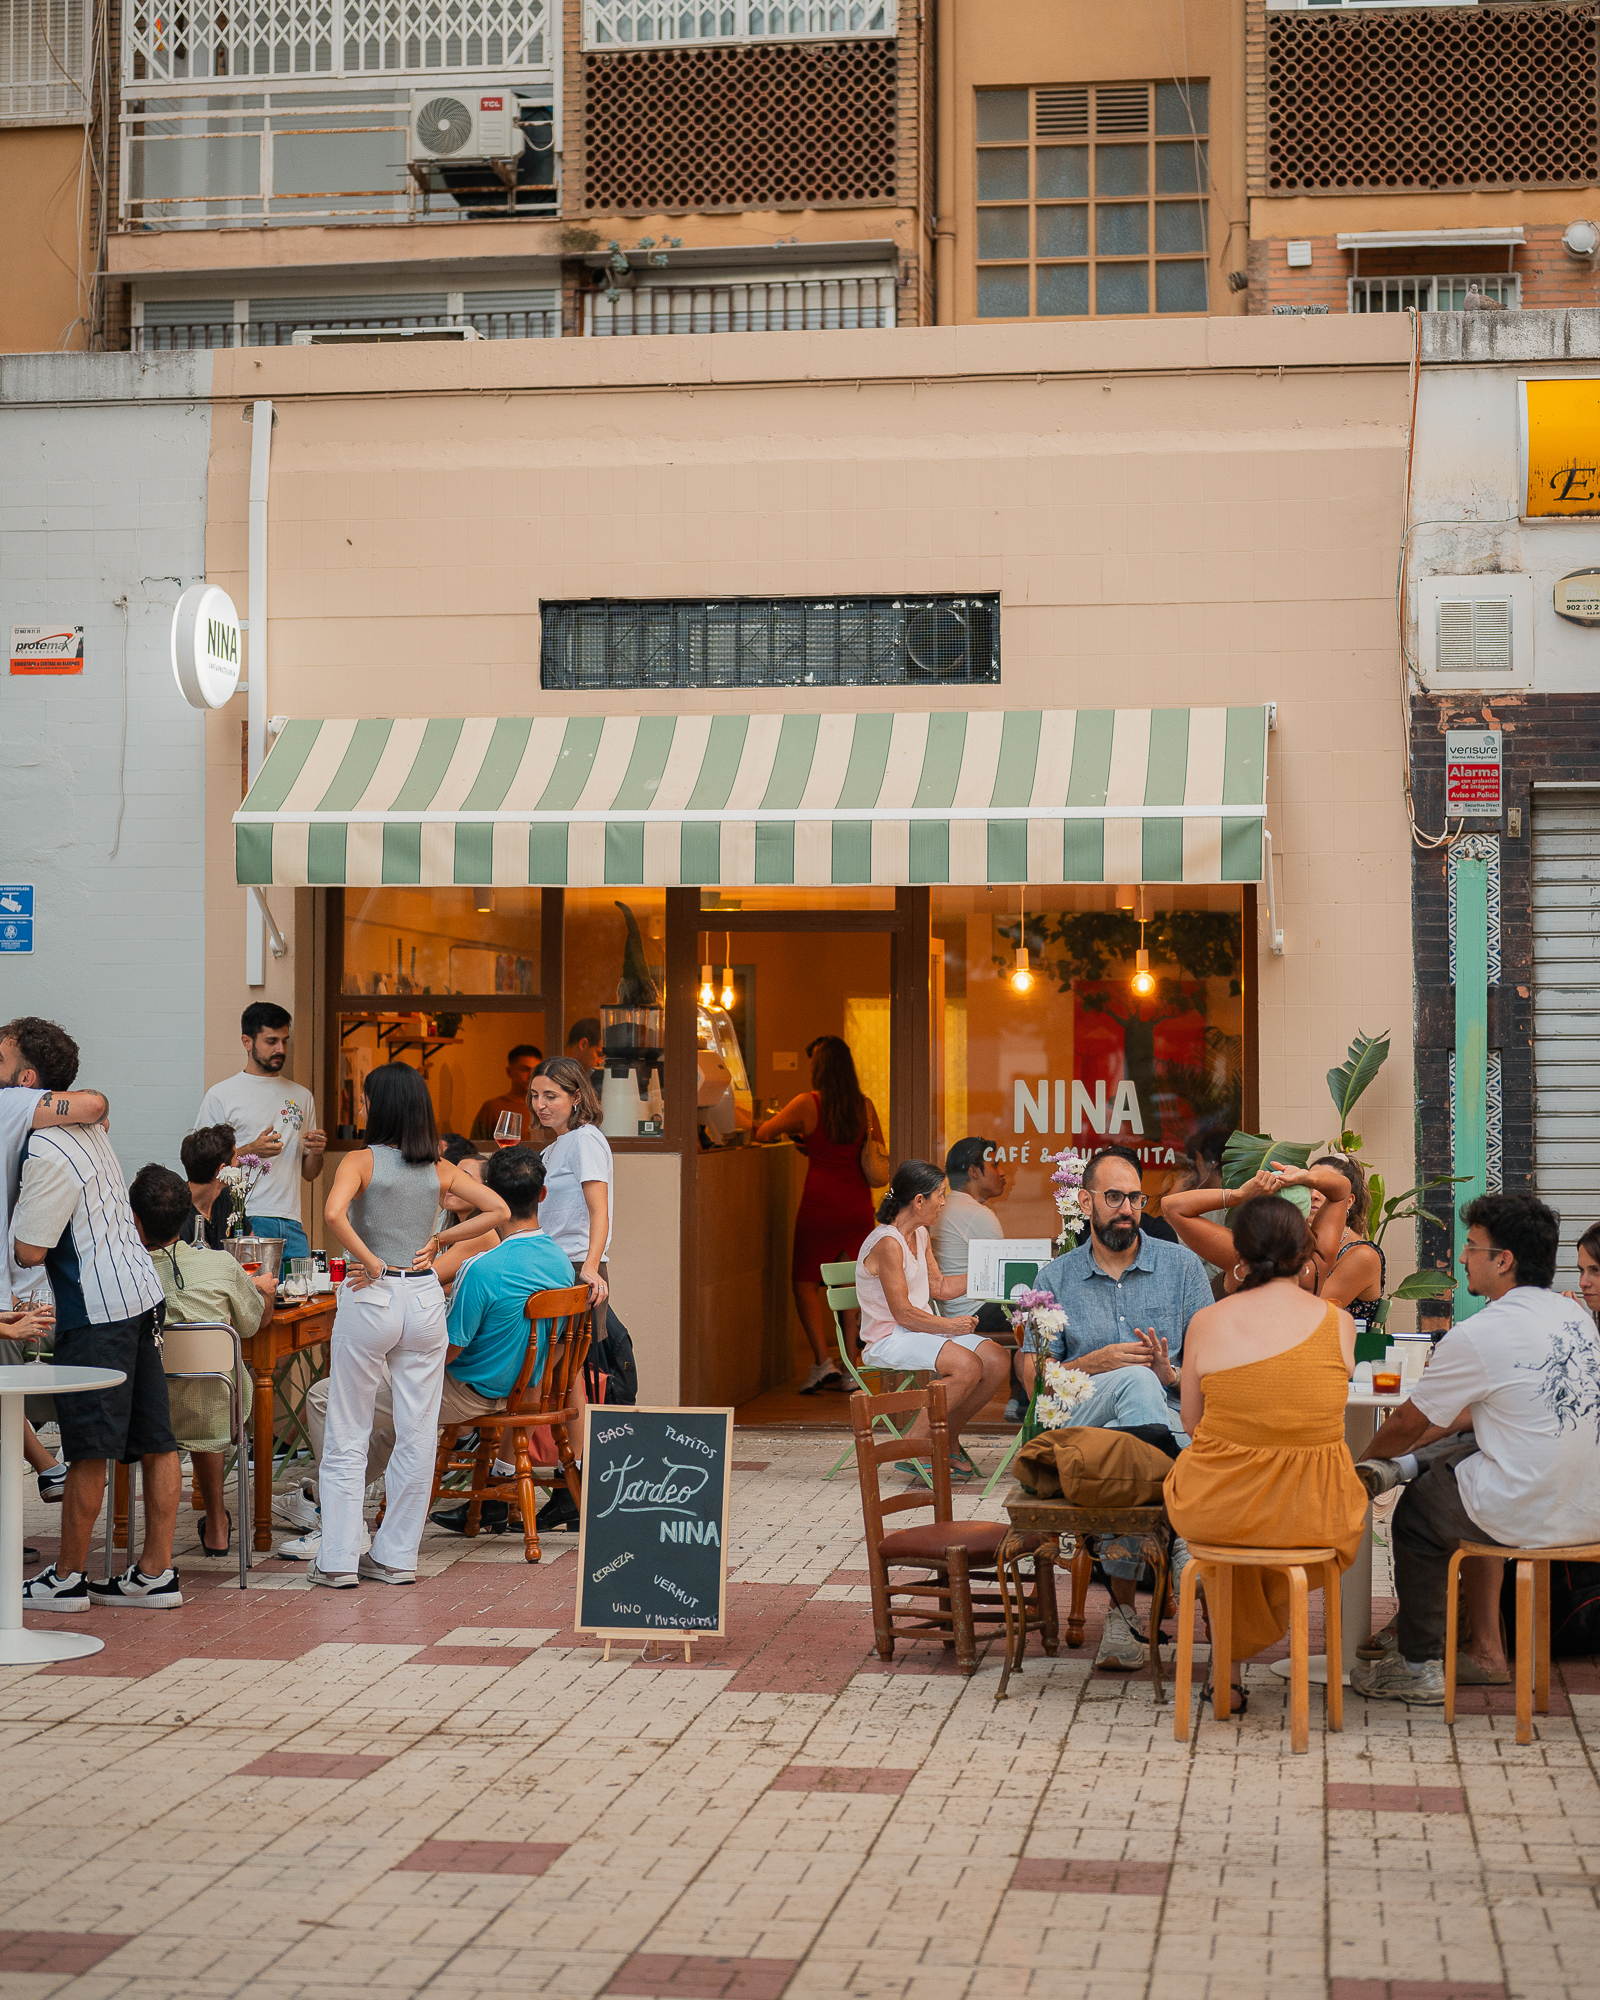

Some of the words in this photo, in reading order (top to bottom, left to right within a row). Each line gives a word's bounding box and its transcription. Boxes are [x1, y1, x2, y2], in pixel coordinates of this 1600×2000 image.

[1550, 467, 1600, 501] E
[15, 639, 71, 654] protemax
[207, 618, 238, 664] NINA
[1450, 766, 1498, 776] Alarma
[1014, 1079, 1145, 1135] NINA
[983, 1140, 1031, 1164] CAFÉ
[1040, 1147, 1050, 1162] &
[597, 1423, 634, 1444] BAOS
[597, 1455, 709, 1518] Tardeo
[660, 1520, 720, 1548] NINA
[592, 1551, 635, 1583] CERVEZA
[653, 1574, 699, 1608] VERMUT
